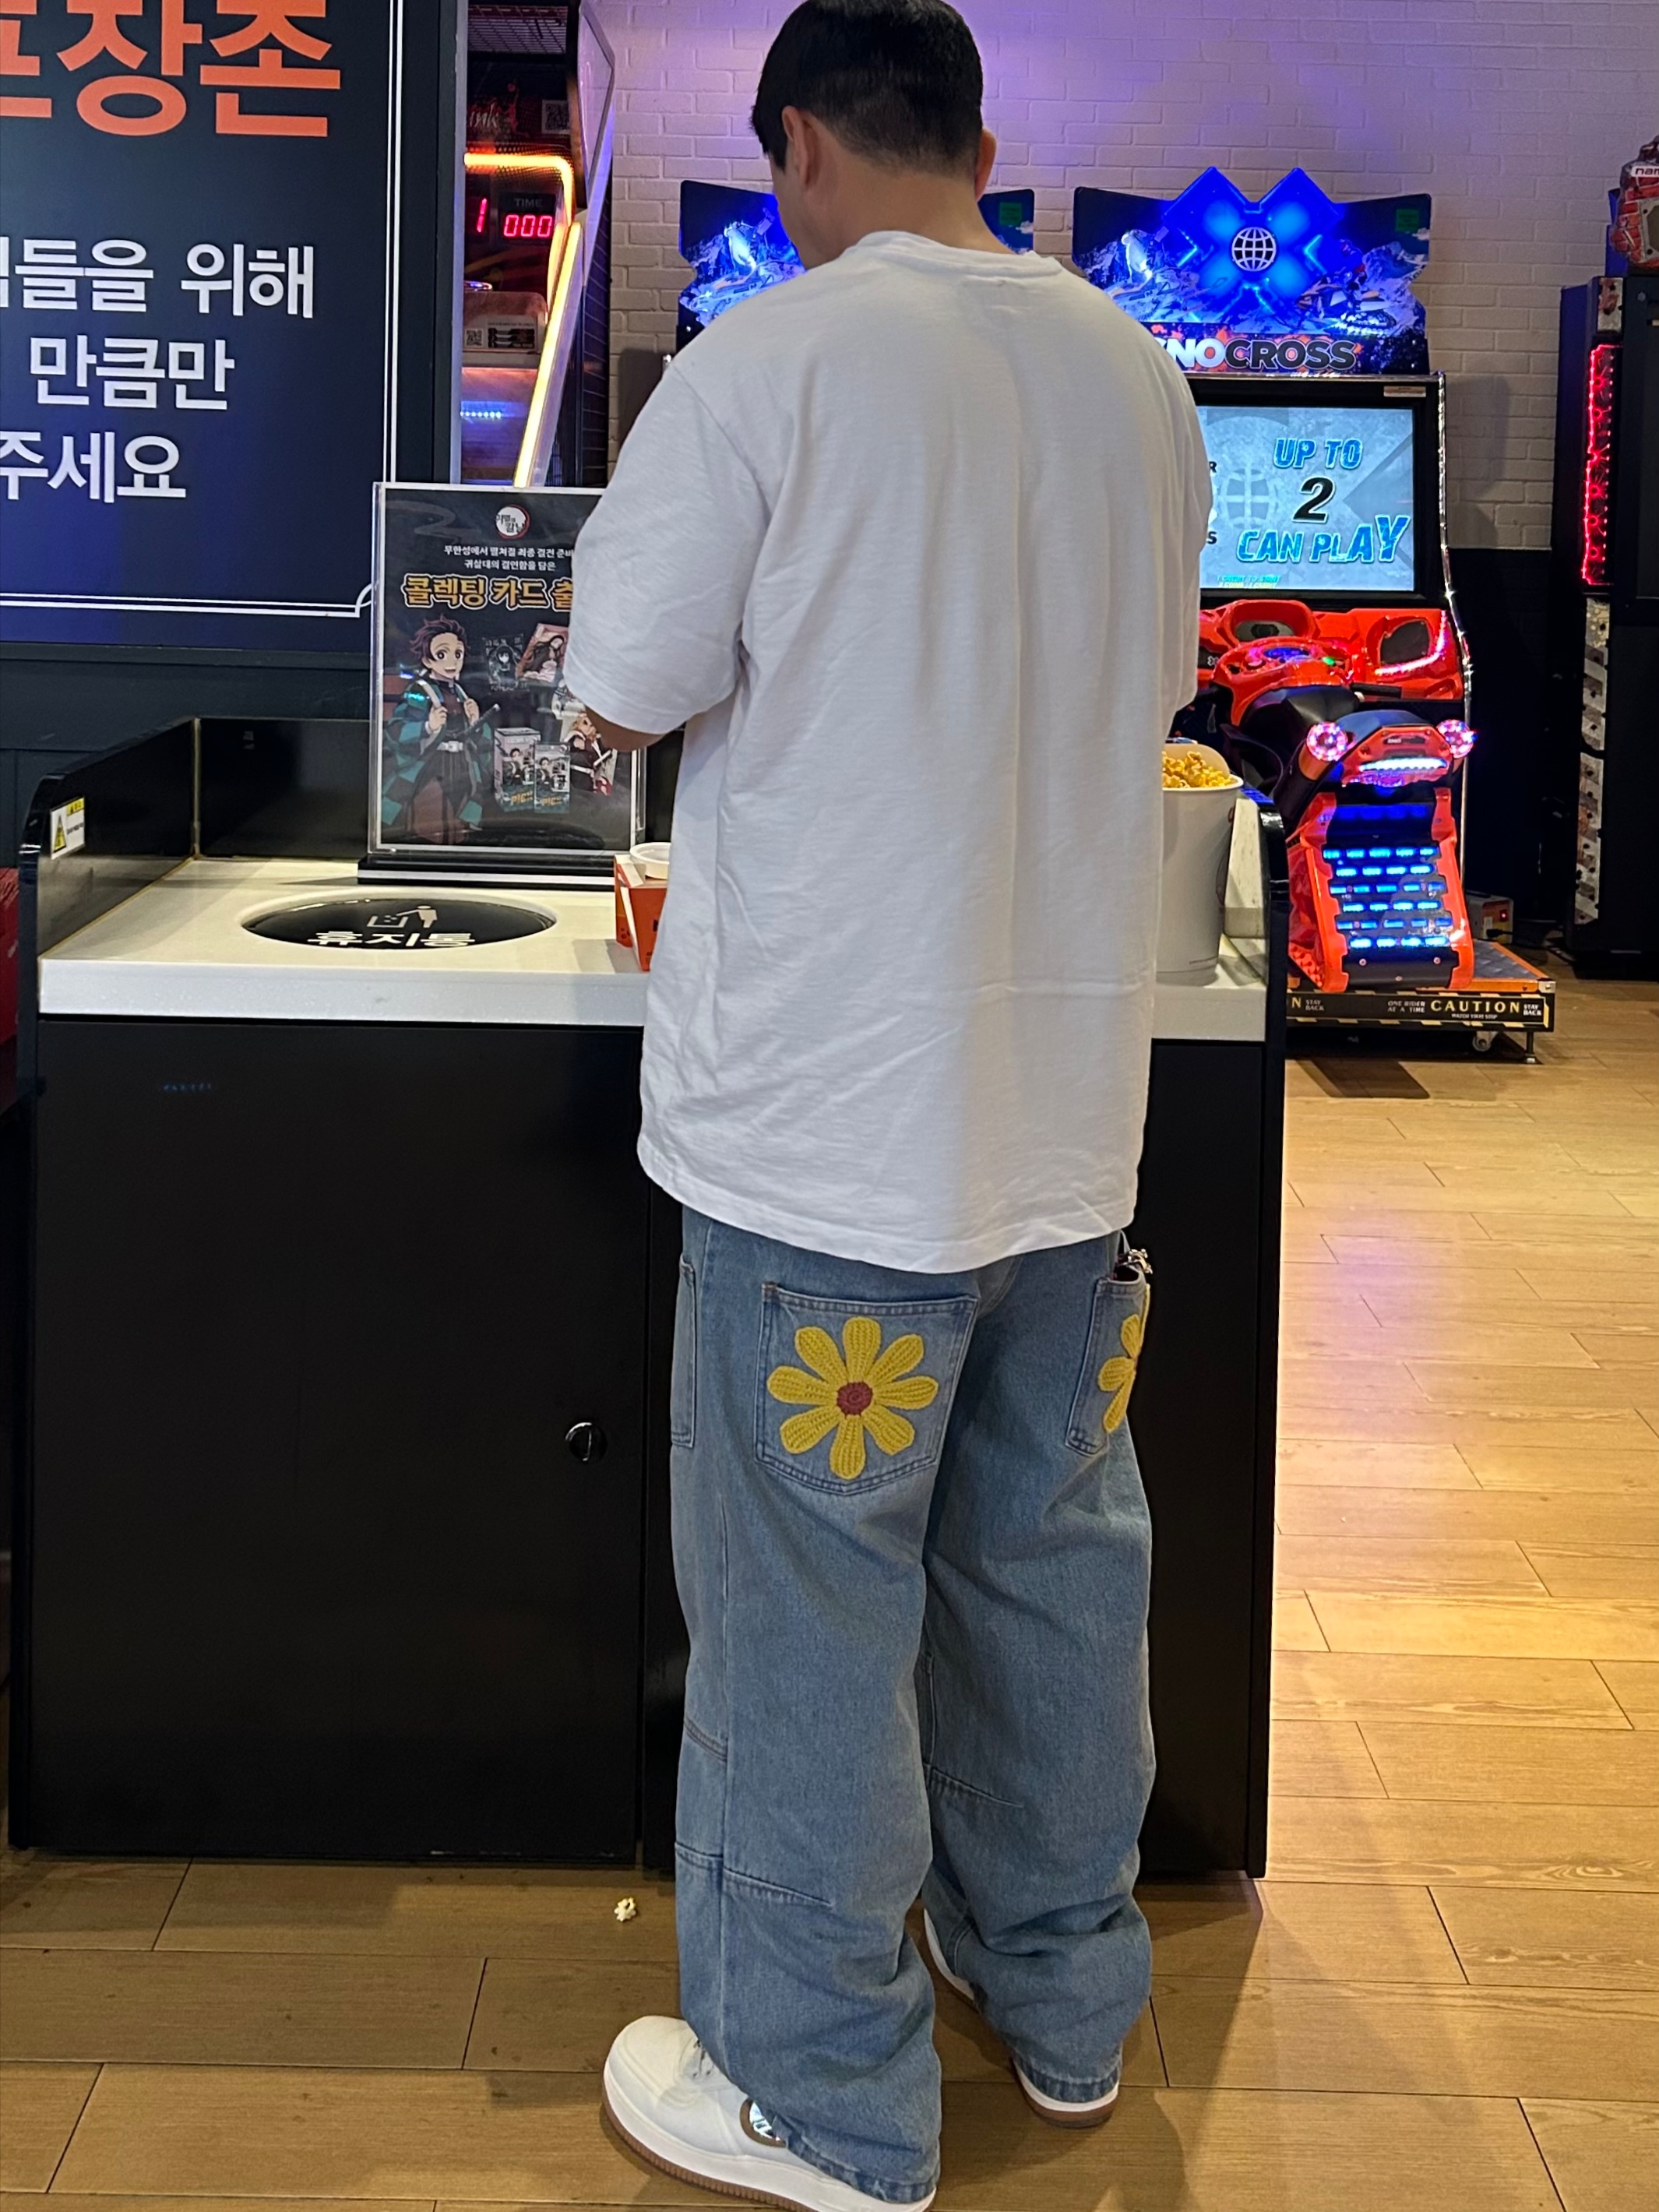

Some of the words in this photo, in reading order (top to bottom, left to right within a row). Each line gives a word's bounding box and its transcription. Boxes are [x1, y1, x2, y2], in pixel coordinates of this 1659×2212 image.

[514, 198, 543, 207] TIME
[504, 214, 552, 238] 000
[0, 237, 153, 312] 들을
[181, 243, 313, 319] 위해
[1154, 336, 1358, 370] NOCROSS
[30, 335, 235, 410] 만큼만
[0, 431, 187, 503] 주세요
[1273, 438, 1316, 469] UP
[1325, 438, 1363, 470] TO
[1292, 476, 1336, 523] 2
[517, 548, 535, 558] 최종
[1236, 529, 1305, 563] CAN
[1309, 515, 1411, 562] PLAY
[464, 559, 499, 569] 귀살대의
[537, 561, 556, 571] 담은
[402, 574, 488, 609] 콜렉팅
[489, 576, 551, 610] 카드
[308, 931, 475, 946] 휴지통
[1430, 999, 1520, 1013] CAUTION
